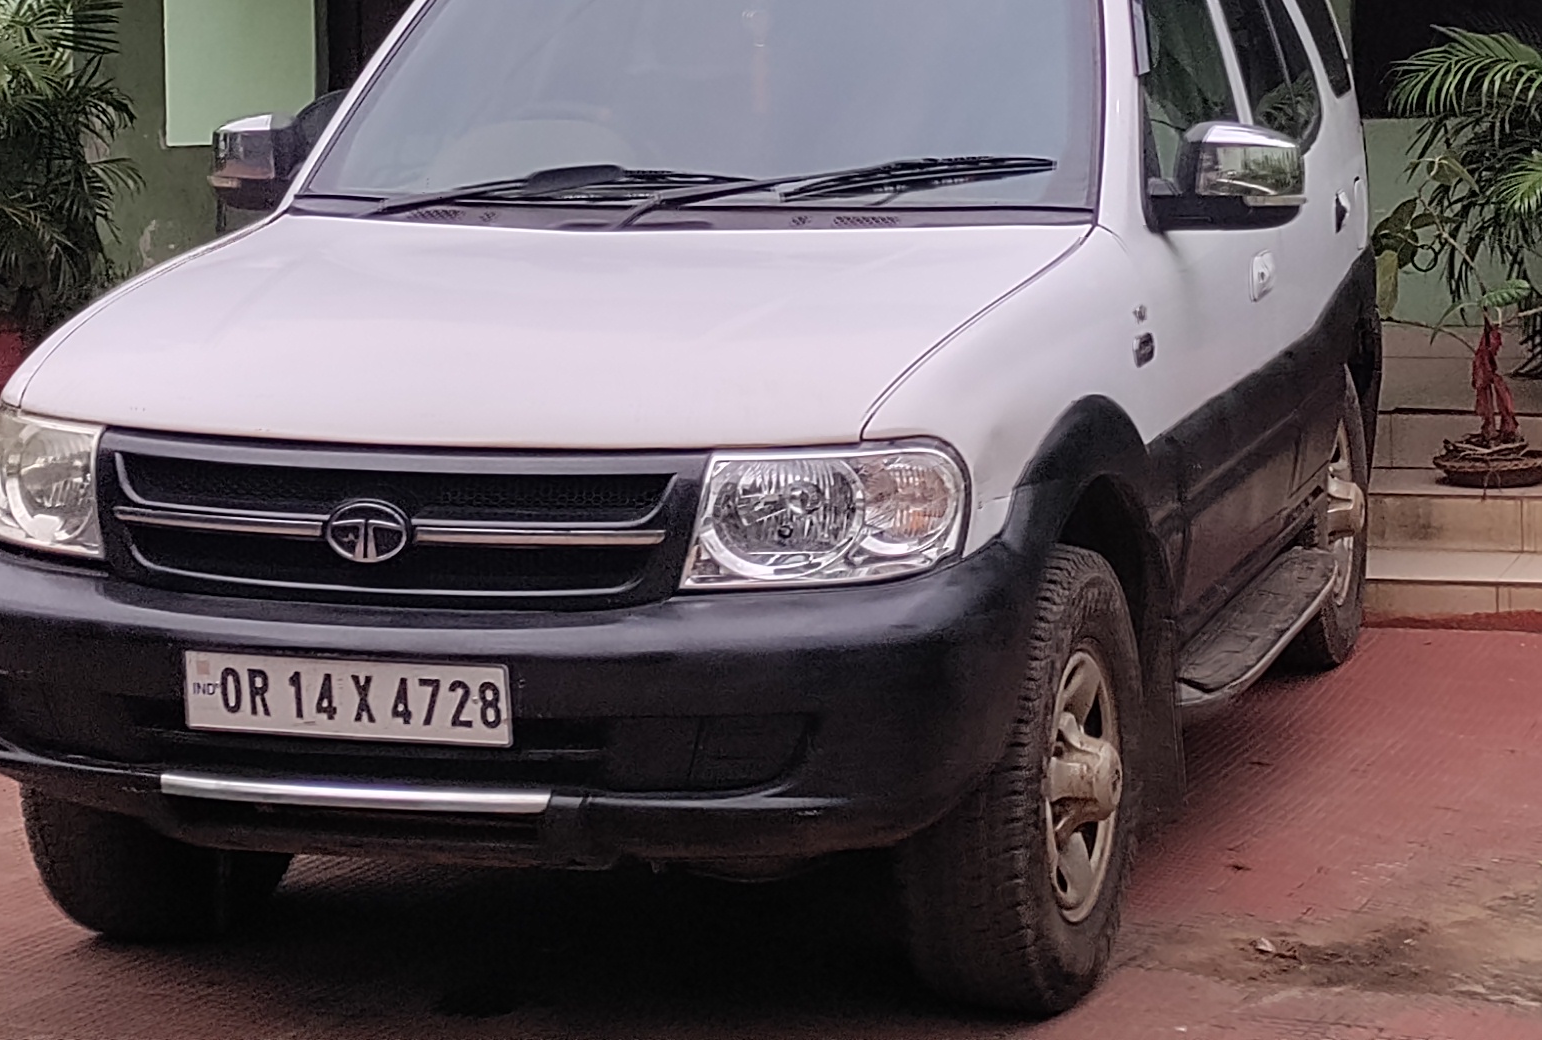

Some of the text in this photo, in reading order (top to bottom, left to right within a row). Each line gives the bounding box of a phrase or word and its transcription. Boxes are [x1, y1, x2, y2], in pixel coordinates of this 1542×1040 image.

[220, 667, 503, 729] OR 14 X 4728
